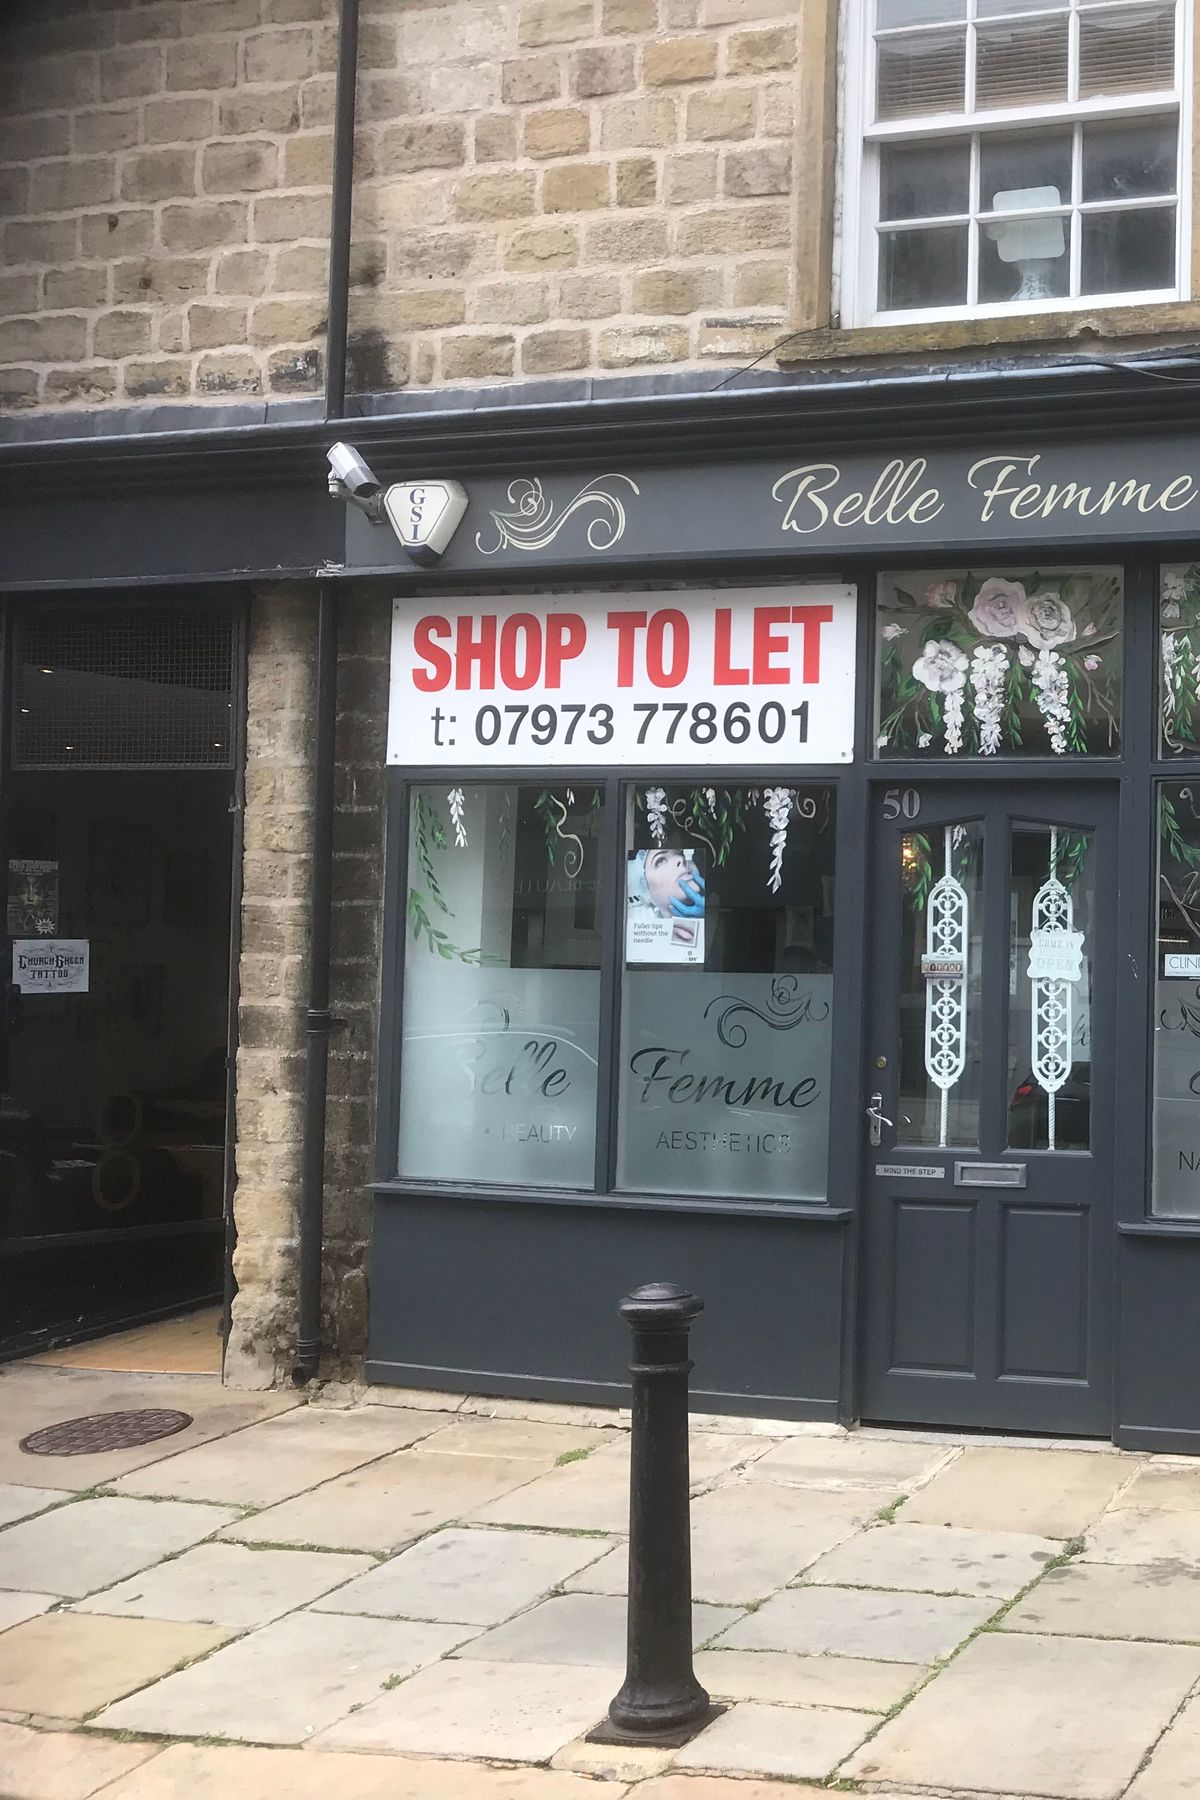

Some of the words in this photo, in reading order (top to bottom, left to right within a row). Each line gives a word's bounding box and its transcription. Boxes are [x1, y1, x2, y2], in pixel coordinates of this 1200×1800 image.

[409, 487, 426, 541] GSI
[771, 458, 945, 533] Belle
[966, 454, 1199, 522] Femme
[411, 613, 588, 693] SHOP
[606, 608, 691, 689] TO
[713, 604, 834, 686] LET
[430, 707, 456, 746] t:
[474, 702, 615, 746] 07973
[633, 700, 810, 745] 778601
[882, 788, 920, 820] 50
[652, 922, 663, 931] lips
[629, 1046, 822, 1108] Femme
[655, 1130, 791, 1154] AESTHETICS
[883, 1167, 901, 1175] MIND
[903, 1167, 917, 1175] THE
[918, 1168, 937, 1176] STEP
